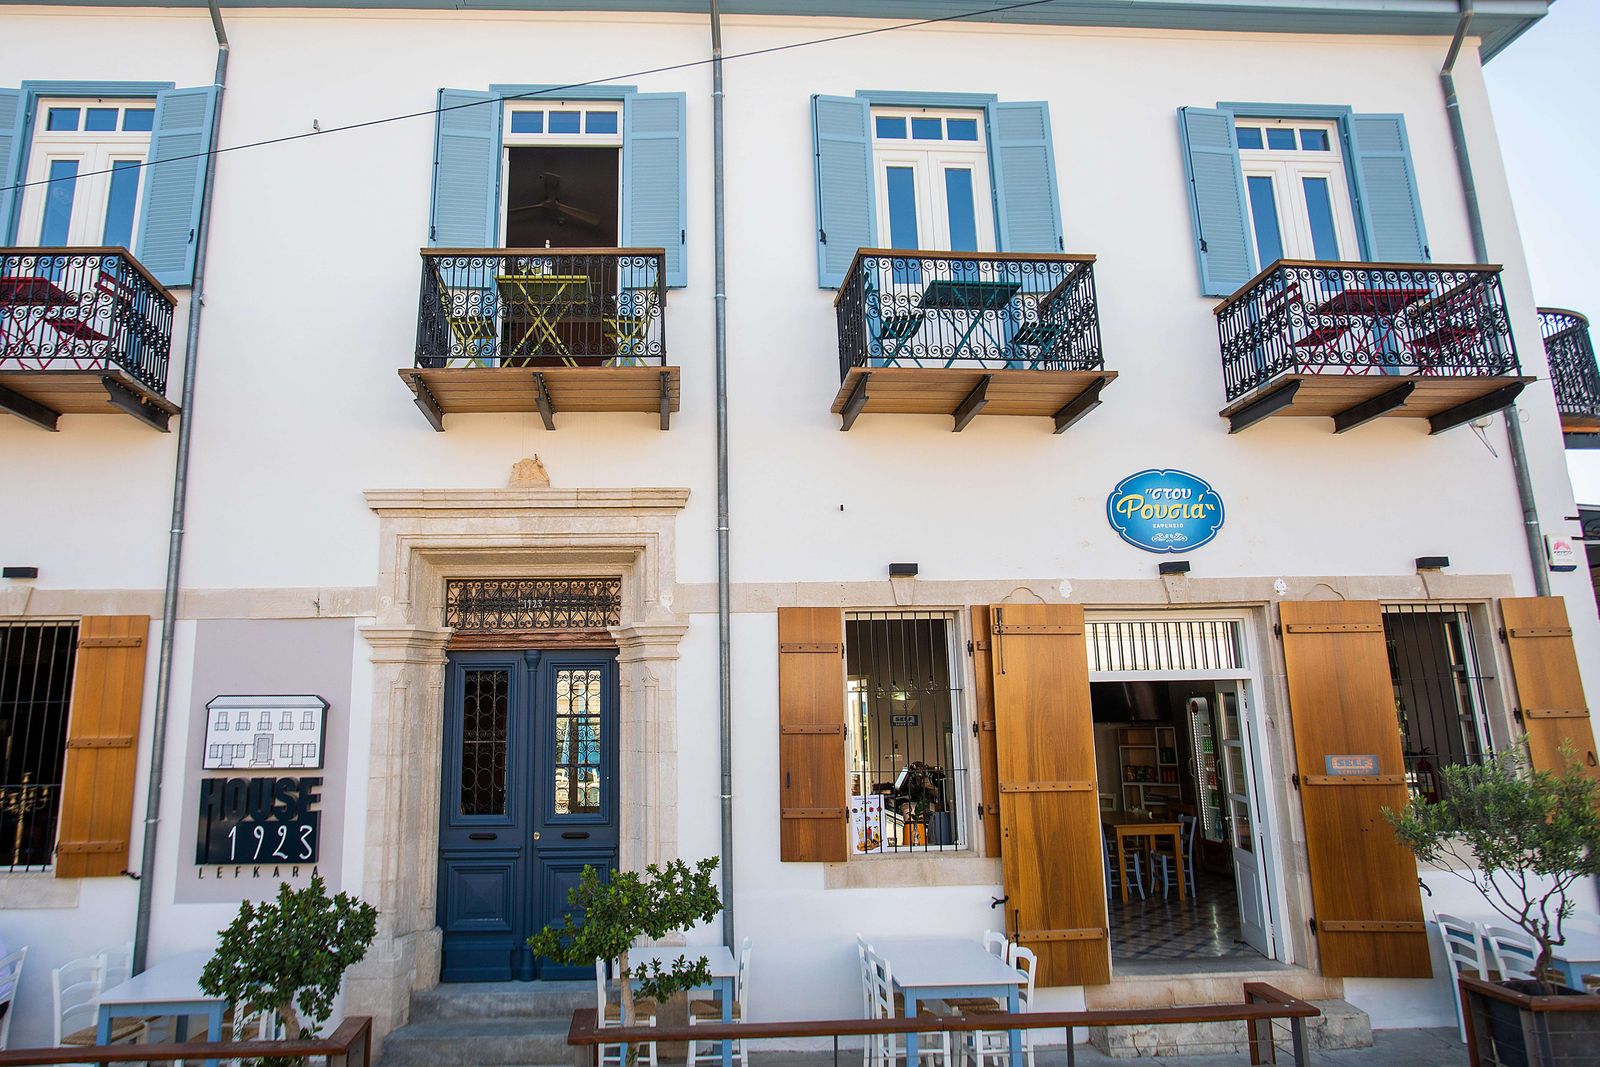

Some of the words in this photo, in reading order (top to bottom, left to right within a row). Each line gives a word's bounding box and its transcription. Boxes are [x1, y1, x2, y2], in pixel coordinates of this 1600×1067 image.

[1334, 758, 1371, 768] SELF
[200, 776, 323, 821] HOUSE
[228, 824, 313, 861] 1923
[198, 865, 319, 879] LEFKARA
